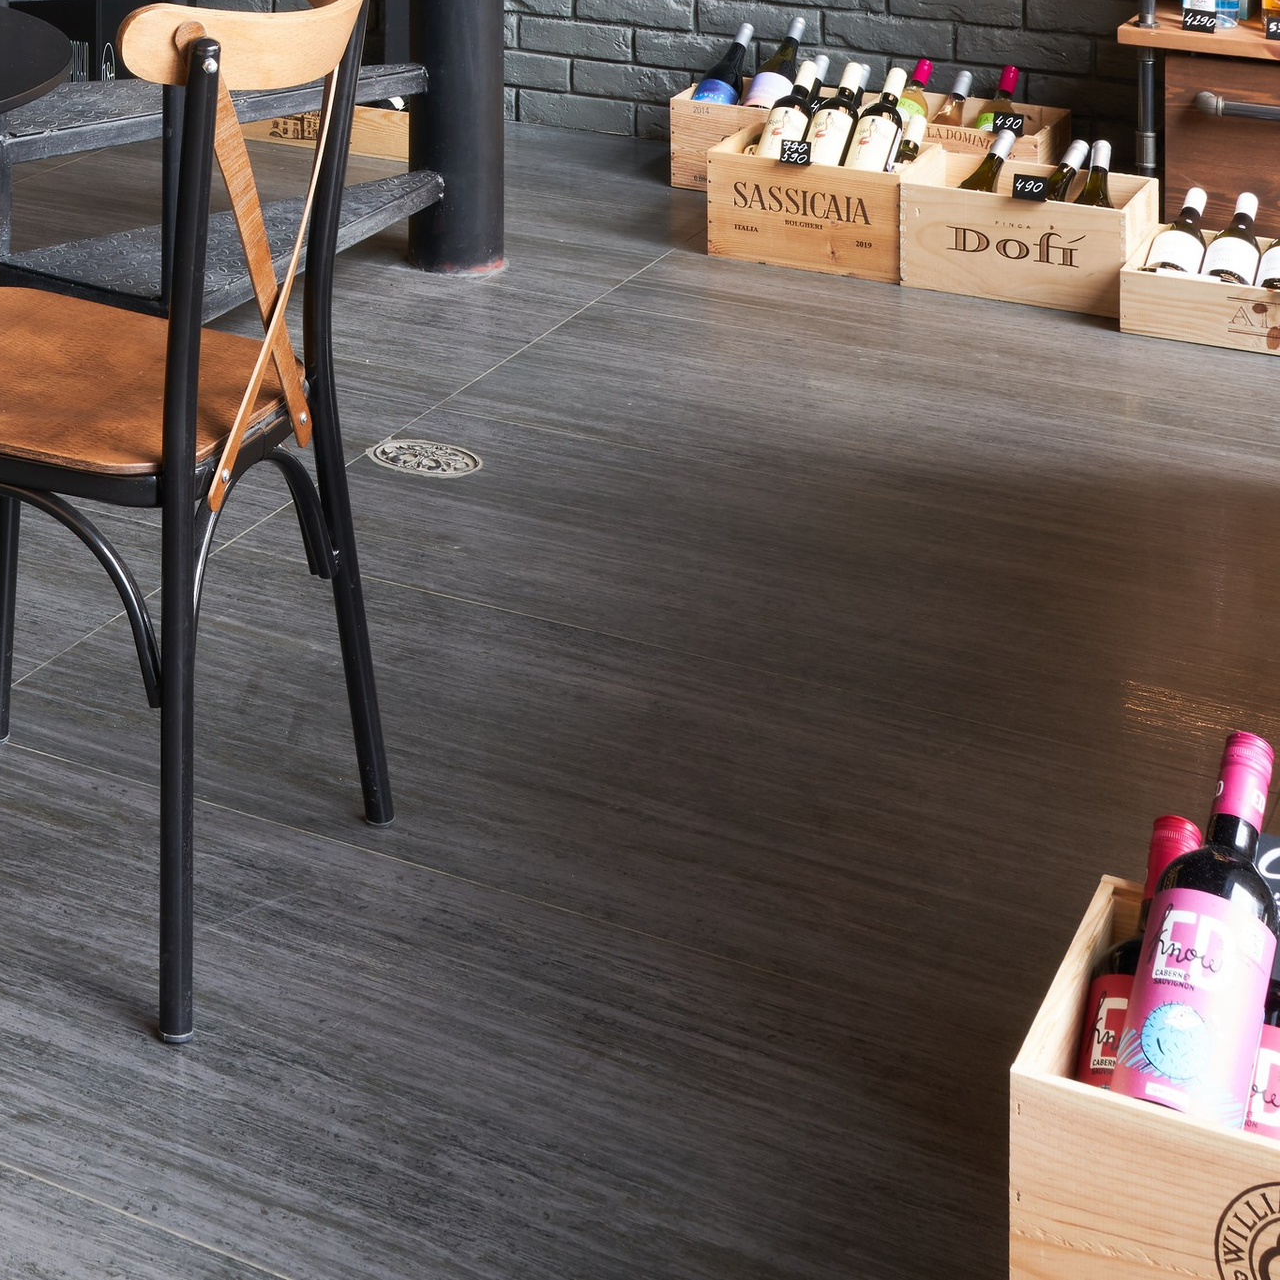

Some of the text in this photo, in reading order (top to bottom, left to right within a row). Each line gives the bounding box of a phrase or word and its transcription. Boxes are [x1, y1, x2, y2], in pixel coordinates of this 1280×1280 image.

[1184, 12, 1216, 27] 4290
[692, 105, 710, 115] 2014
[994, 115, 1023, 129] 490
[927, 126, 943, 139] LA
[781, 151, 808, 164] 590
[1015, 178, 1044, 193] 490
[733, 181, 872, 226] SASSICAIA
[733, 224, 759, 233] ITALIA
[784, 219, 823, 230] BOLGHERI
[995, 220, 1032, 230] FINCA
[855, 240, 873, 249] 2019
[1252, 789, 1266, 814] ED
[1153, 978, 1195, 992] SAUVIGNON
